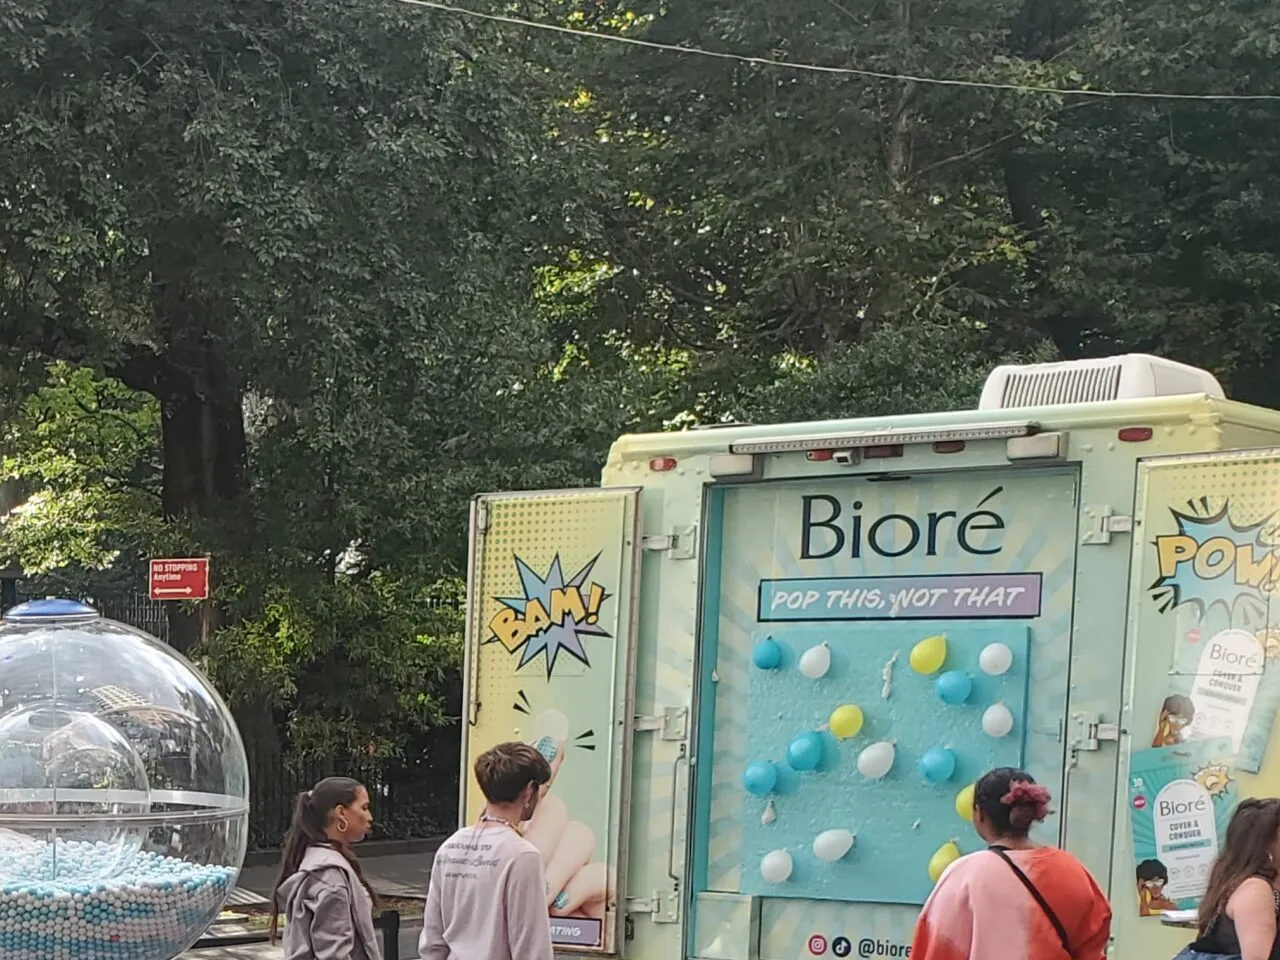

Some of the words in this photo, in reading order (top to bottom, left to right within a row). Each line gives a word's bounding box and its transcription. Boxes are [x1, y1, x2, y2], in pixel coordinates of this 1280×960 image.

[799, 486, 1005, 560] Bioré
[153, 563, 163, 572] NO
[164, 563, 198, 572] STOPPING
[153, 573, 182, 583] Anytime
[771, 590, 820, 611] POP
[826, 588, 886, 610] THIS,
[891, 588, 948, 609] NOT
[953, 586, 1025, 608] THAT
[488, 581, 606, 656] BAM!
[1209, 643, 1257, 669] Bioré
[1159, 794, 1206, 817] Bioré
[1168, 829, 1202, 841] CONQUER
[1169, 820, 1192, 831] COVER
